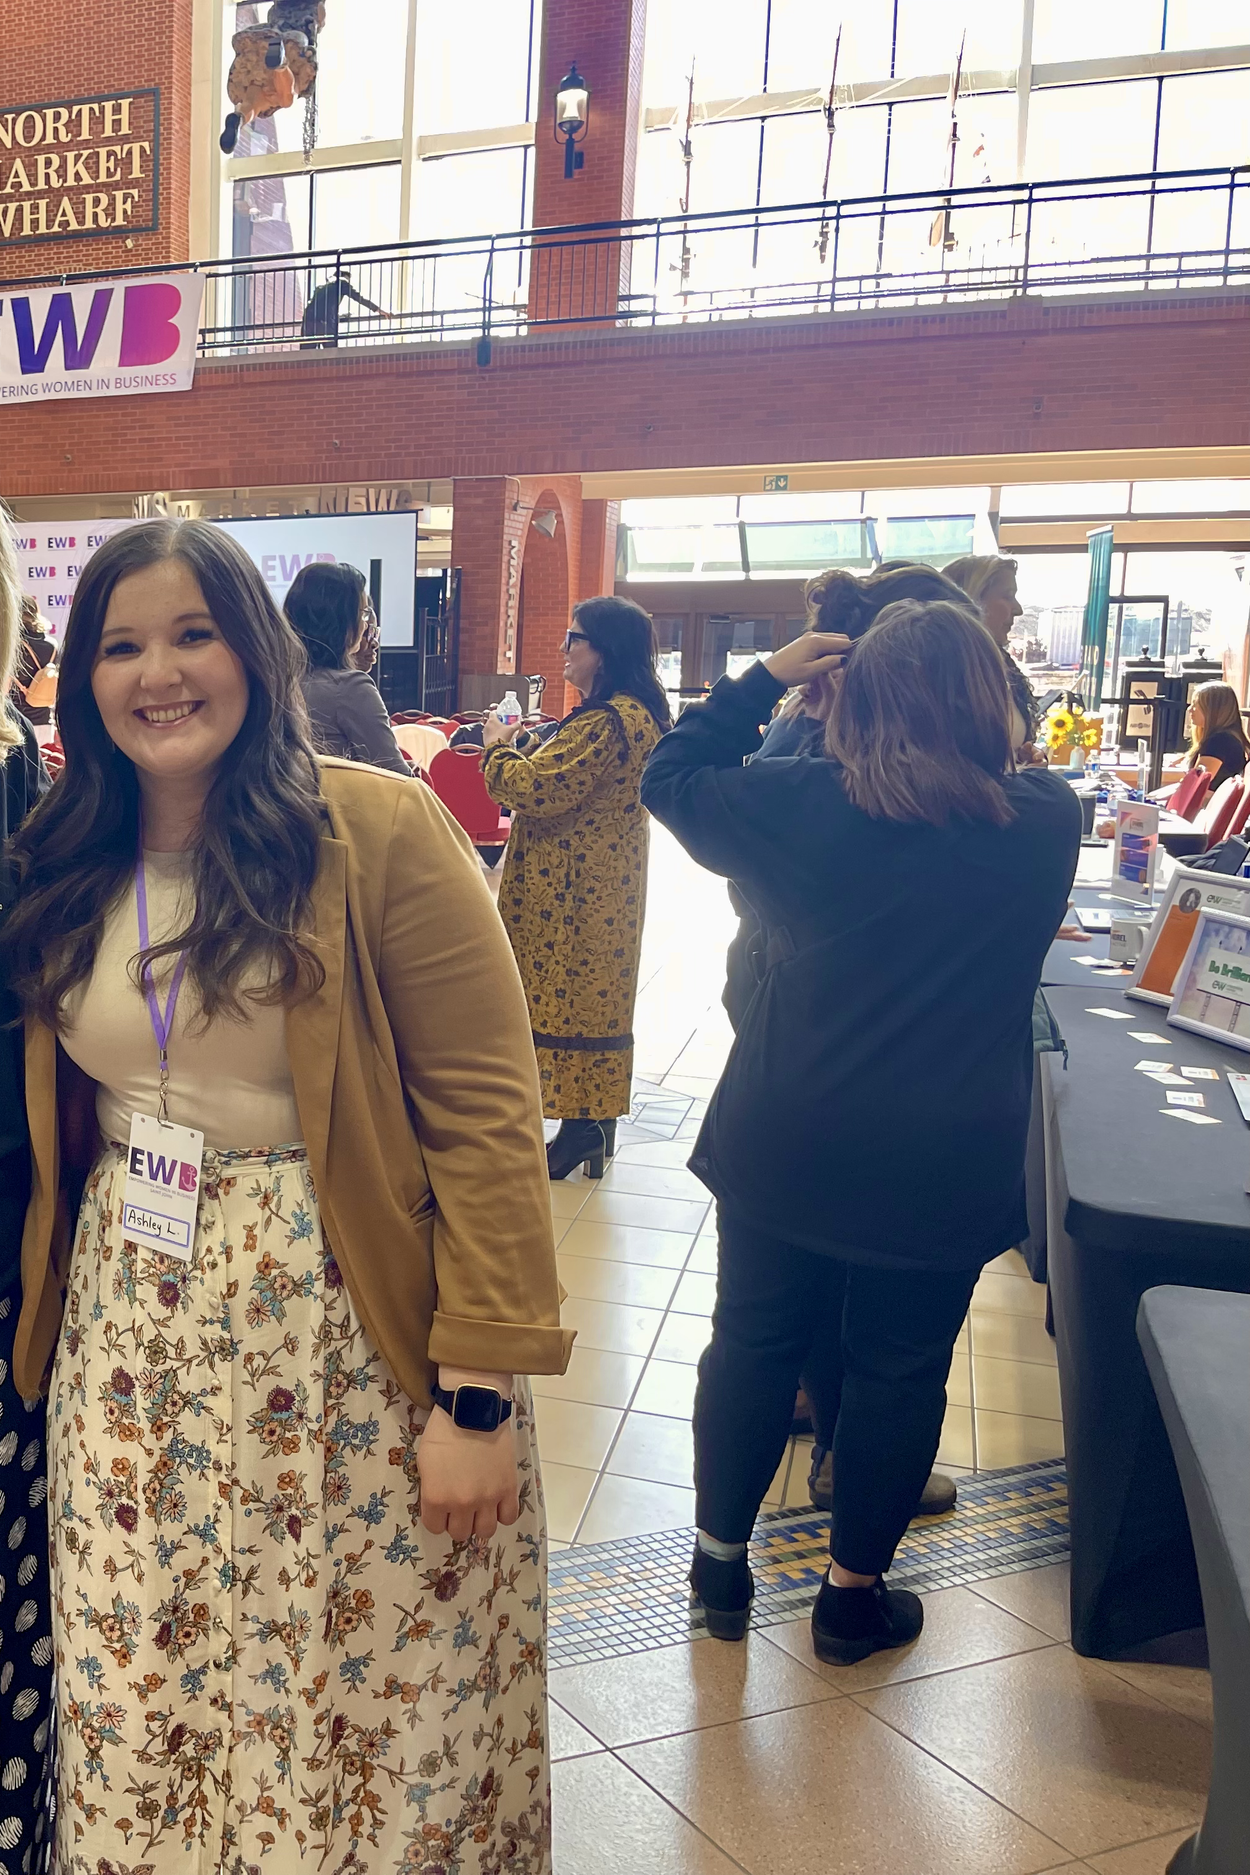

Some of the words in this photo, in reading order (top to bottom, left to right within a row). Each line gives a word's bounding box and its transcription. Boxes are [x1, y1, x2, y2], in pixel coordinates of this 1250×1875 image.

[41, 379, 92, 393] WOMEN
[96, 378, 110, 391] IN
[115, 373, 177, 390] BUSINESS
[47, 536, 76, 549] EWB
[87, 535, 107, 548] EW
[28, 566, 56, 578] EWB
[129, 1146, 198, 1193] EWB
[128, 1175, 155, 1188] EMPOWERING
[155, 1185, 171, 1193] WOMEN
[176, 1191, 196, 1202] BUSINESS
[150, 1188, 161, 1196] SAINT
[128, 1208, 162, 1237] Ashley
